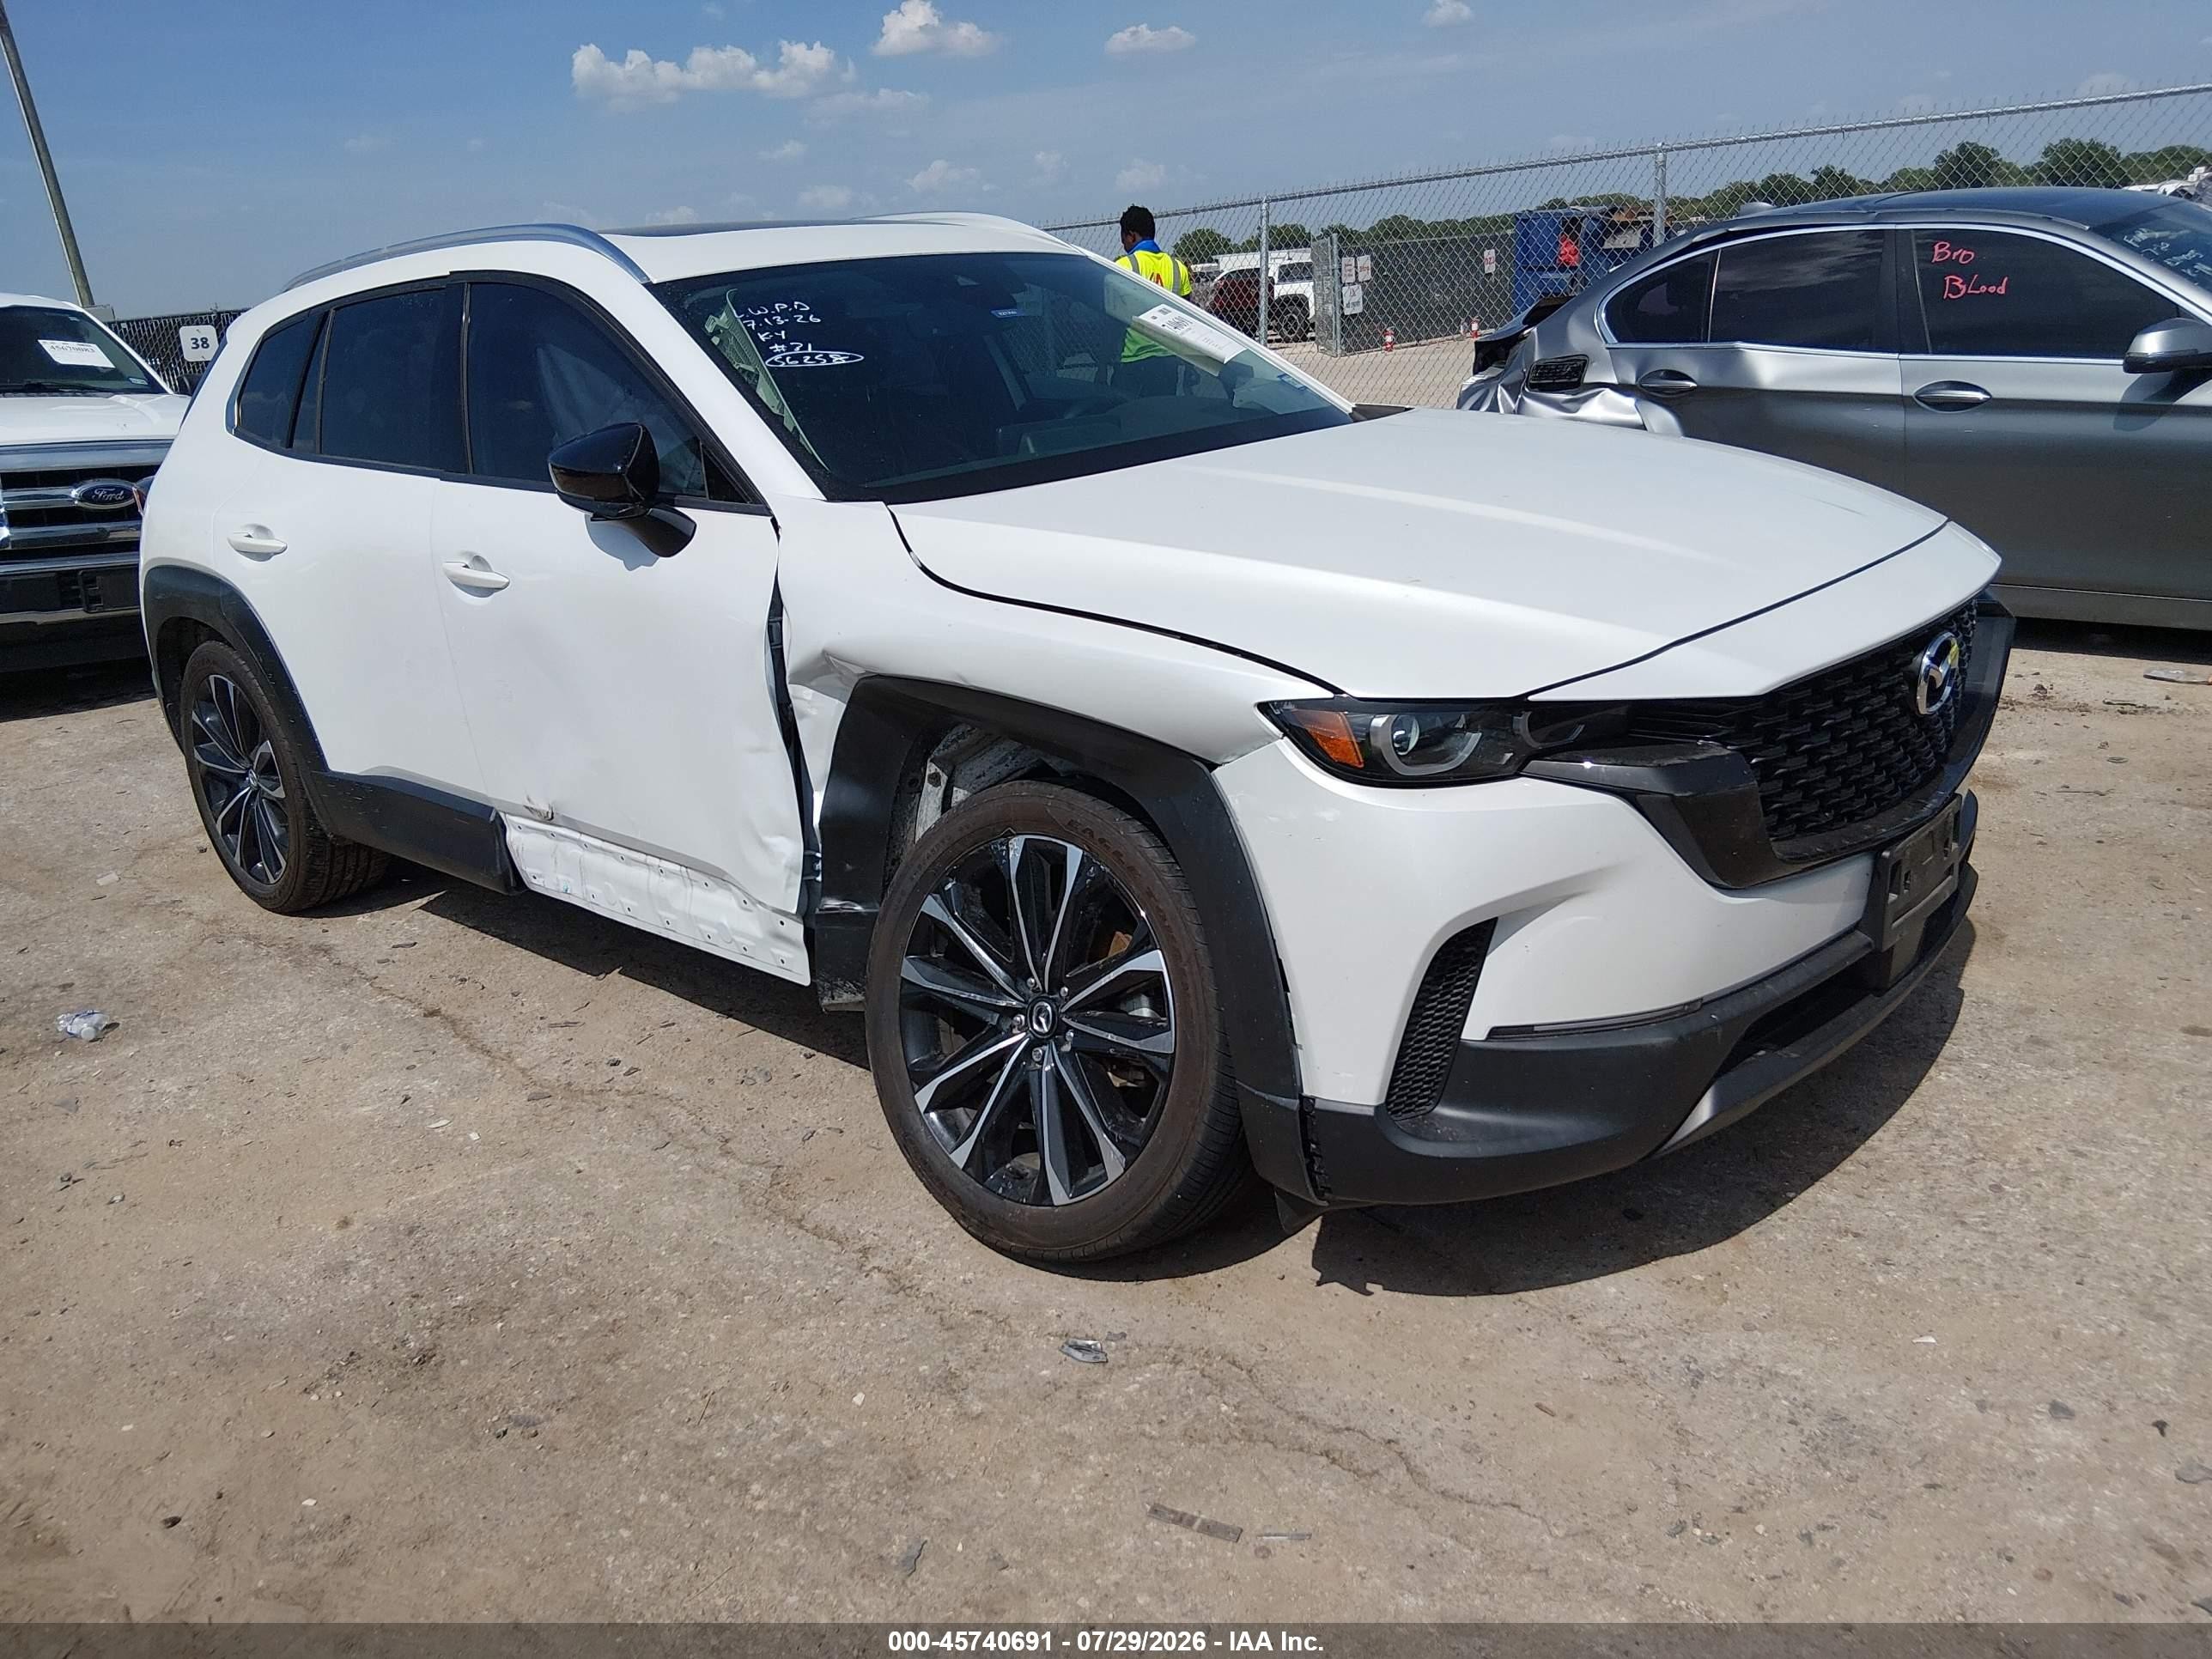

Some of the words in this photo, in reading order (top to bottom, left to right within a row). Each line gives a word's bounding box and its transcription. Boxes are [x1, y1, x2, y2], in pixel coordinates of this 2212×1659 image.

[1931, 241, 1975, 264] Bro
[191, 337, 210, 349] 38
[92, 488, 125, 501] Ford
